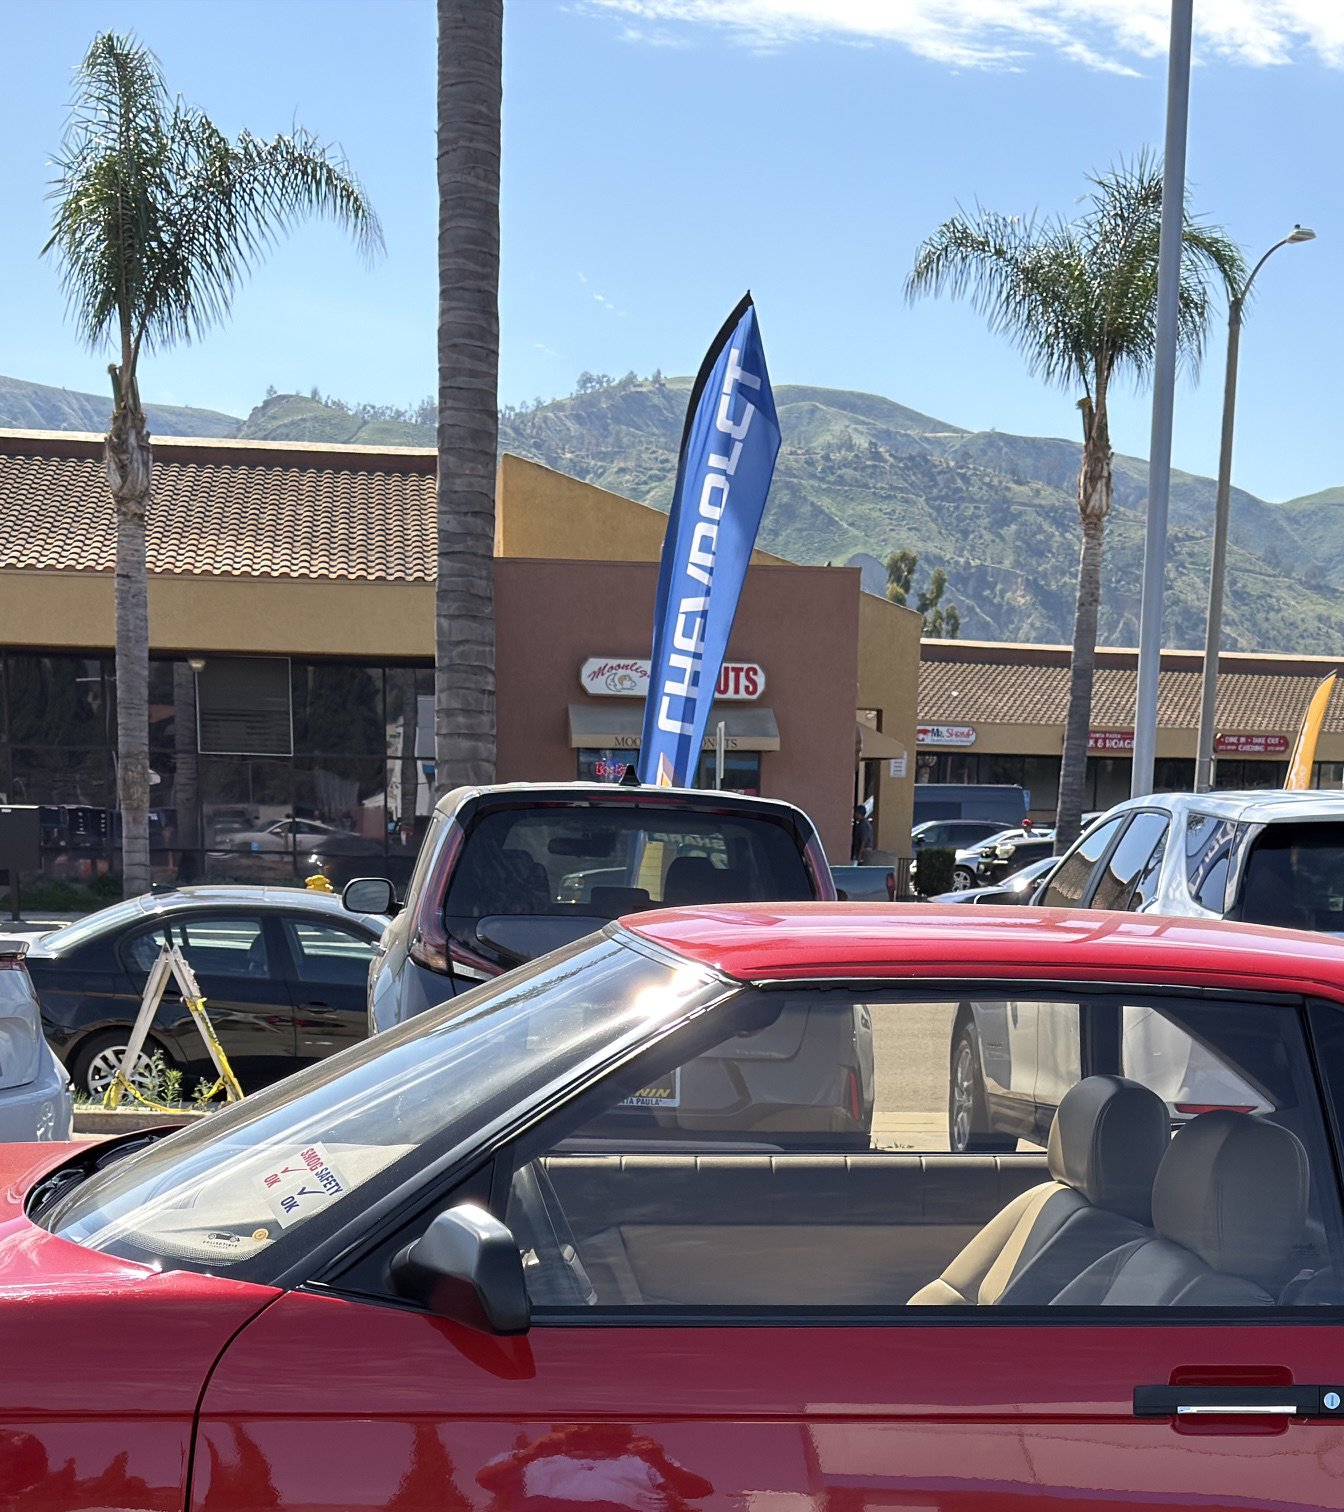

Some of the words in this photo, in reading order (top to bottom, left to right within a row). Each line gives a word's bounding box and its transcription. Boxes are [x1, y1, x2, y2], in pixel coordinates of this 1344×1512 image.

[658, 348, 760, 736] CHEVROLET
[587, 662, 650, 681] Moonlig
[717, 666, 759, 696] UTS
[264, 1173, 281, 1188] OK
[300, 1148, 324, 1172] SMOG
[314, 1167, 343, 1196] SAFETY
[280, 1196, 300, 1214] OK
